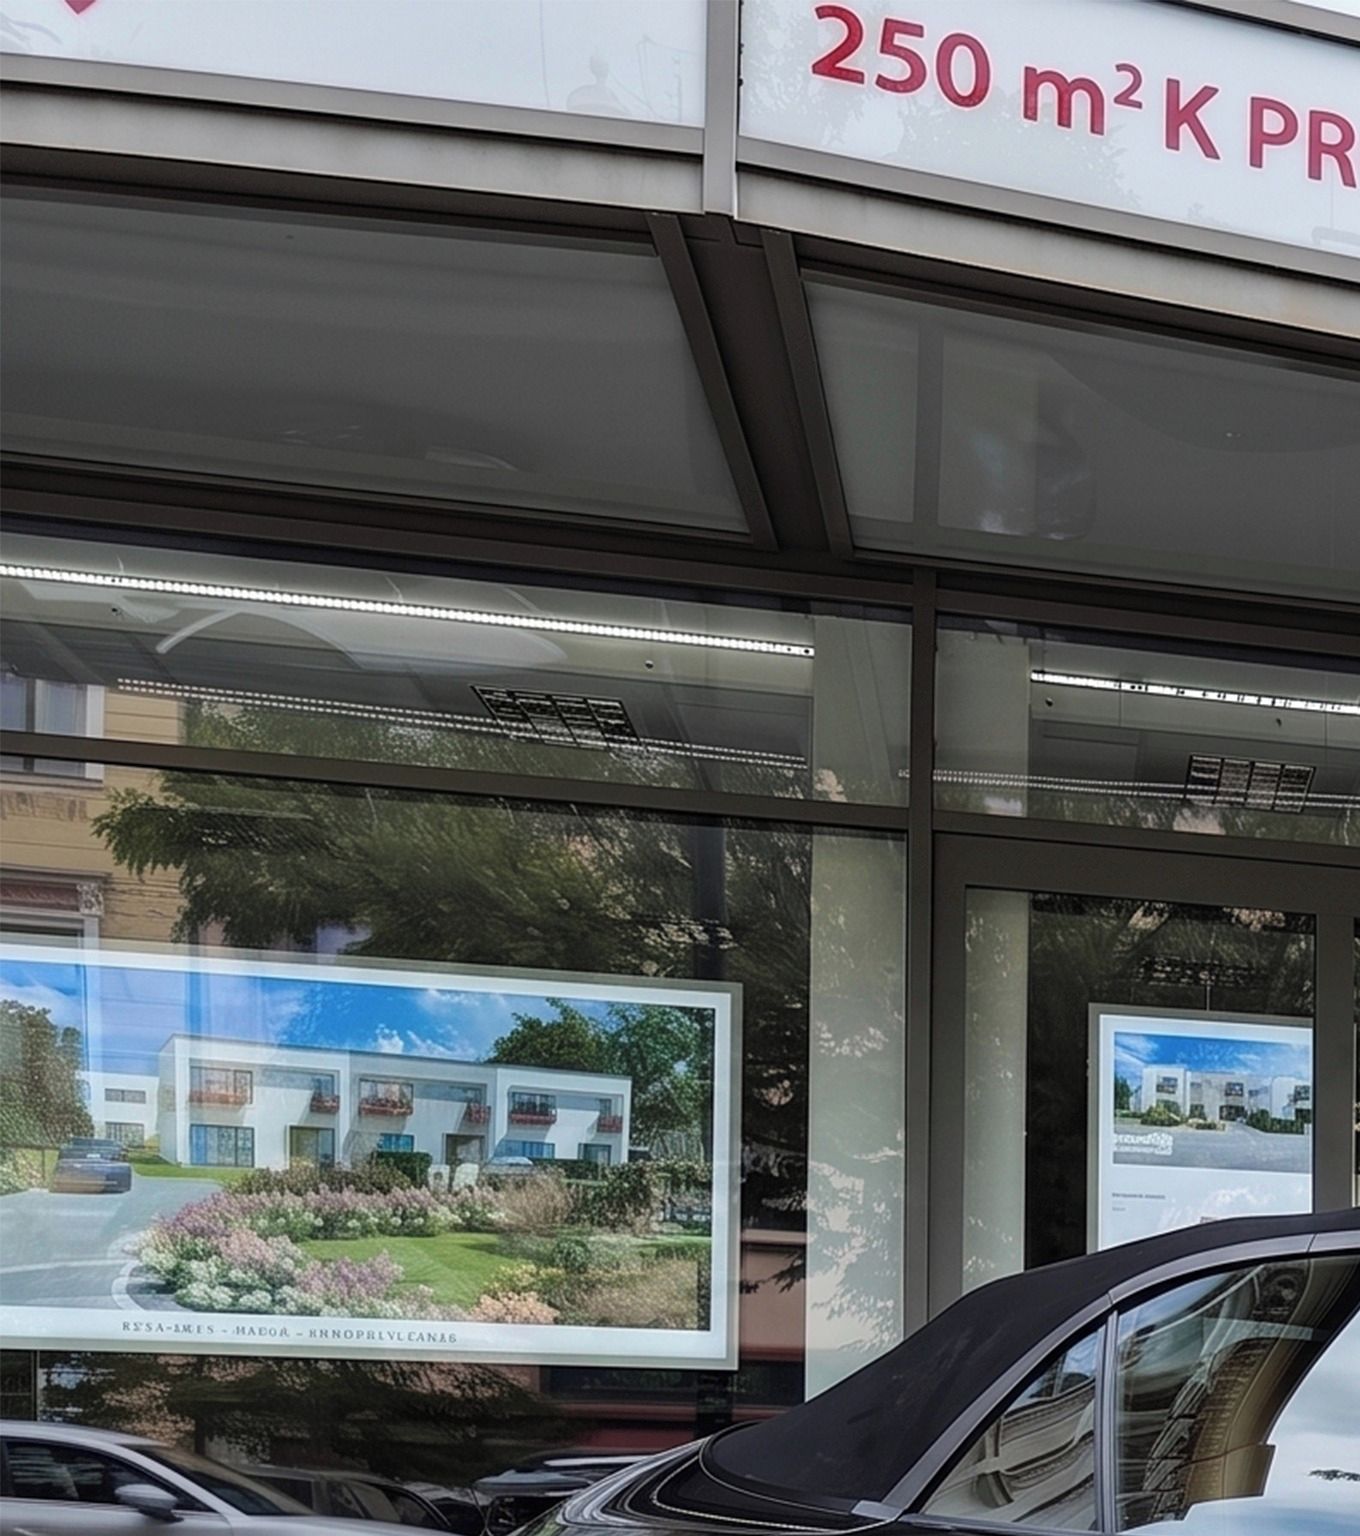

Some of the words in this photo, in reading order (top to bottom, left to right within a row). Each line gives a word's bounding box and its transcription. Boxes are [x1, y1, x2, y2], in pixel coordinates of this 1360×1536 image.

[811, 3, 991, 109] 250
[1023, 63, 1143, 136] m²
[1165, 77, 1221, 161] K
